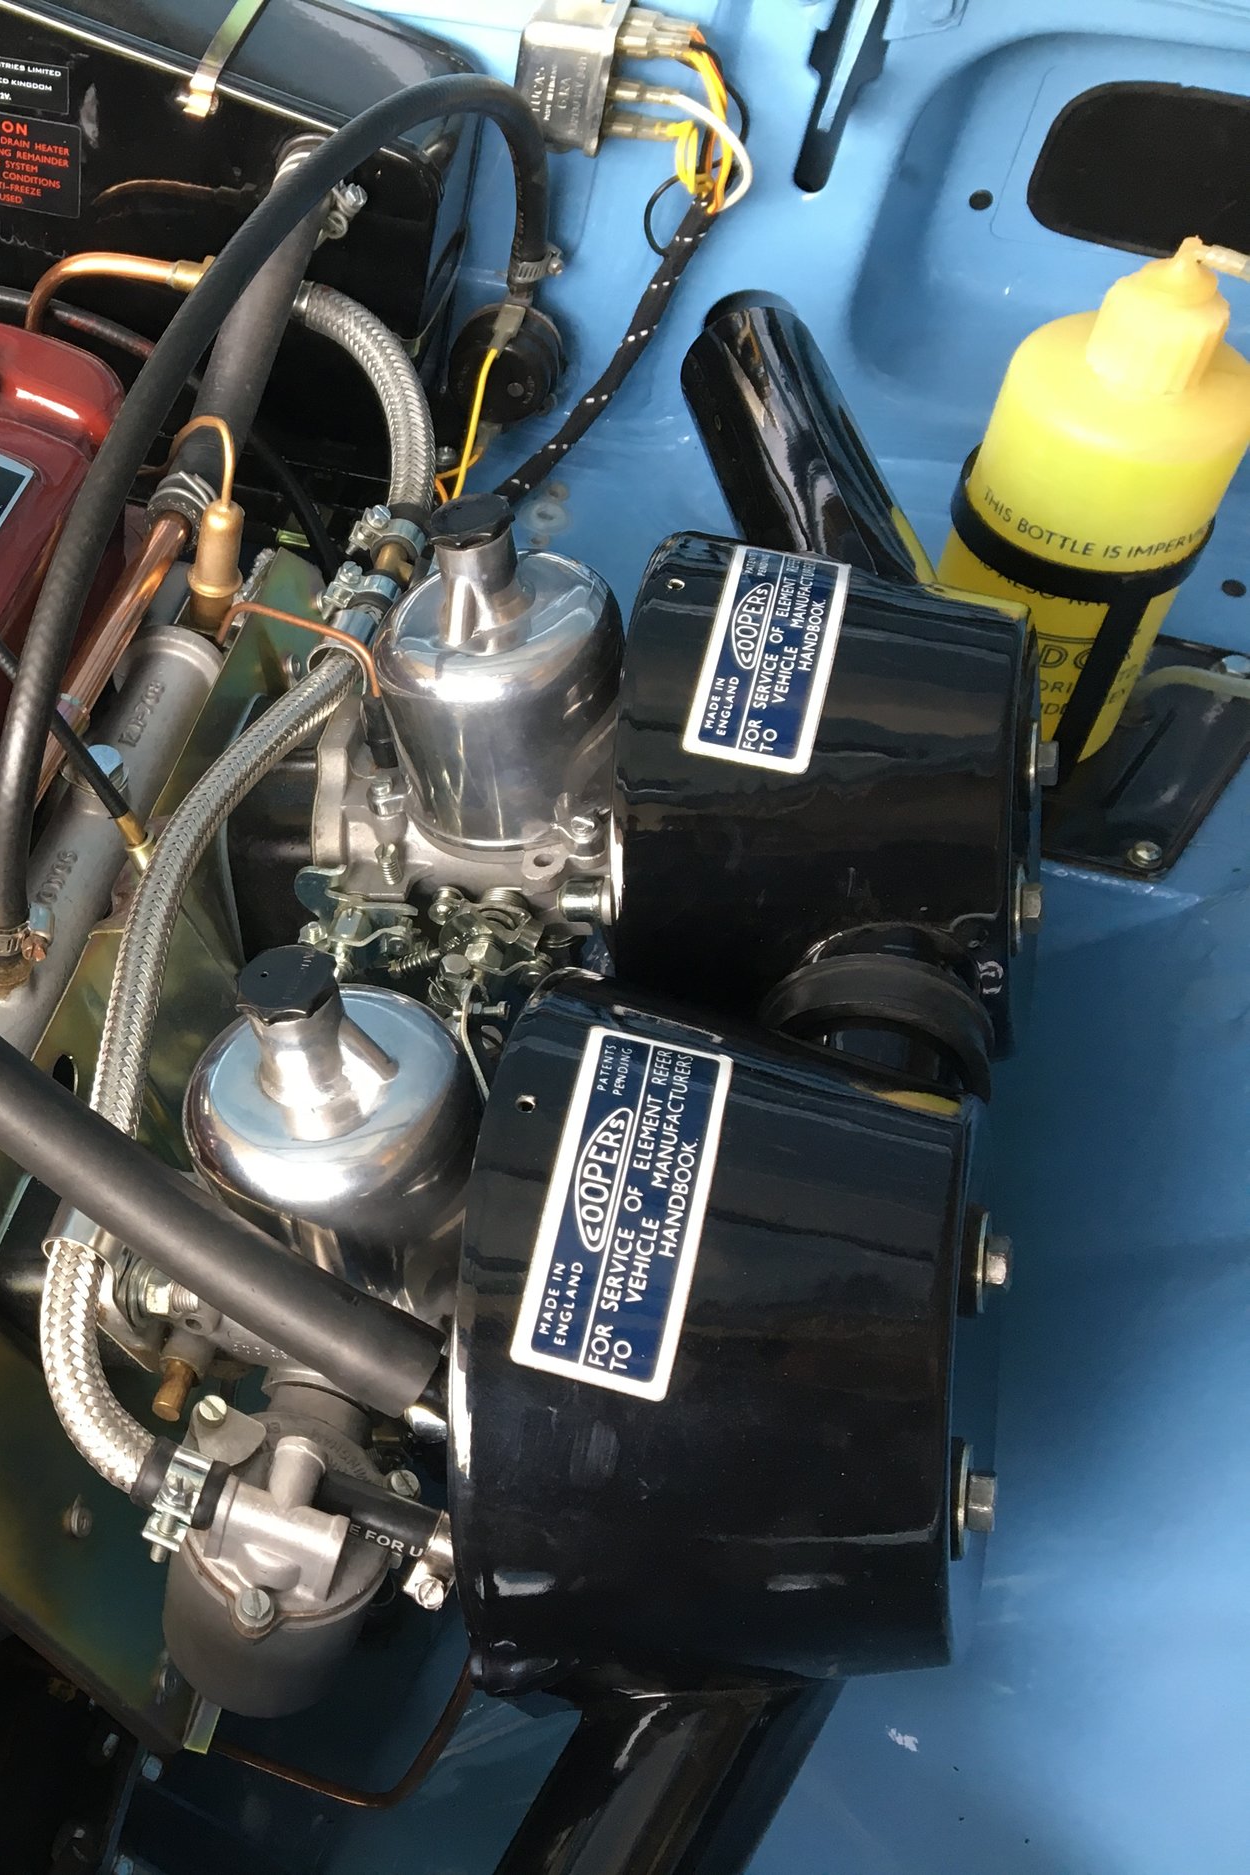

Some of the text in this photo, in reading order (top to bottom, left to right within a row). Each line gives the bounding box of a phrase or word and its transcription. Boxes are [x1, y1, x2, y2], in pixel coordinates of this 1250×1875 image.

[11, 79, 52, 91] KINGDOM
[27, 65, 62, 77] LIMITED
[0, 136, 30, 149] DRAIN
[35, 142, 70, 156] HEATER
[5, 160, 38, 173] SYSTEM
[16, 150, 69, 168] REMAINDER
[2, 170, 61, 189] CONDITIONS
[982, 485, 1012, 523] THIS
[1016, 517, 1096, 557] BOTTLE
[1102, 544, 1121, 559] IS
[776, 576, 796, 618] ELEMENT
[737, 587, 768, 663] COOPERS
[769, 625, 785, 644] OF
[705, 677, 726, 729] MADE IN
[716, 676, 739, 736] ENGLAND
[753, 654, 778, 710] SERVICE
[759, 728, 778, 753] TO
[772, 646, 798, 704] VEHICLE
[742, 719, 763, 751] FOR
[597, 1044, 617, 1092] PATENTS
[612, 1047, 633, 1096] PENDING
[580, 1118, 626, 1243] COOPERS
[658, 1137, 700, 1259] HANDBOOK.
[587, 1049, 673, 1368] FOR SERVICE OF ELEMENT REFER
[608, 1053, 695, 1371] TO VEHICLE MANUFACTURERS
[538, 1262, 565, 1336] MADE IN
[553, 1260, 584, 1347] ENGLAND
[365, 1530, 405, 1553] FOR
